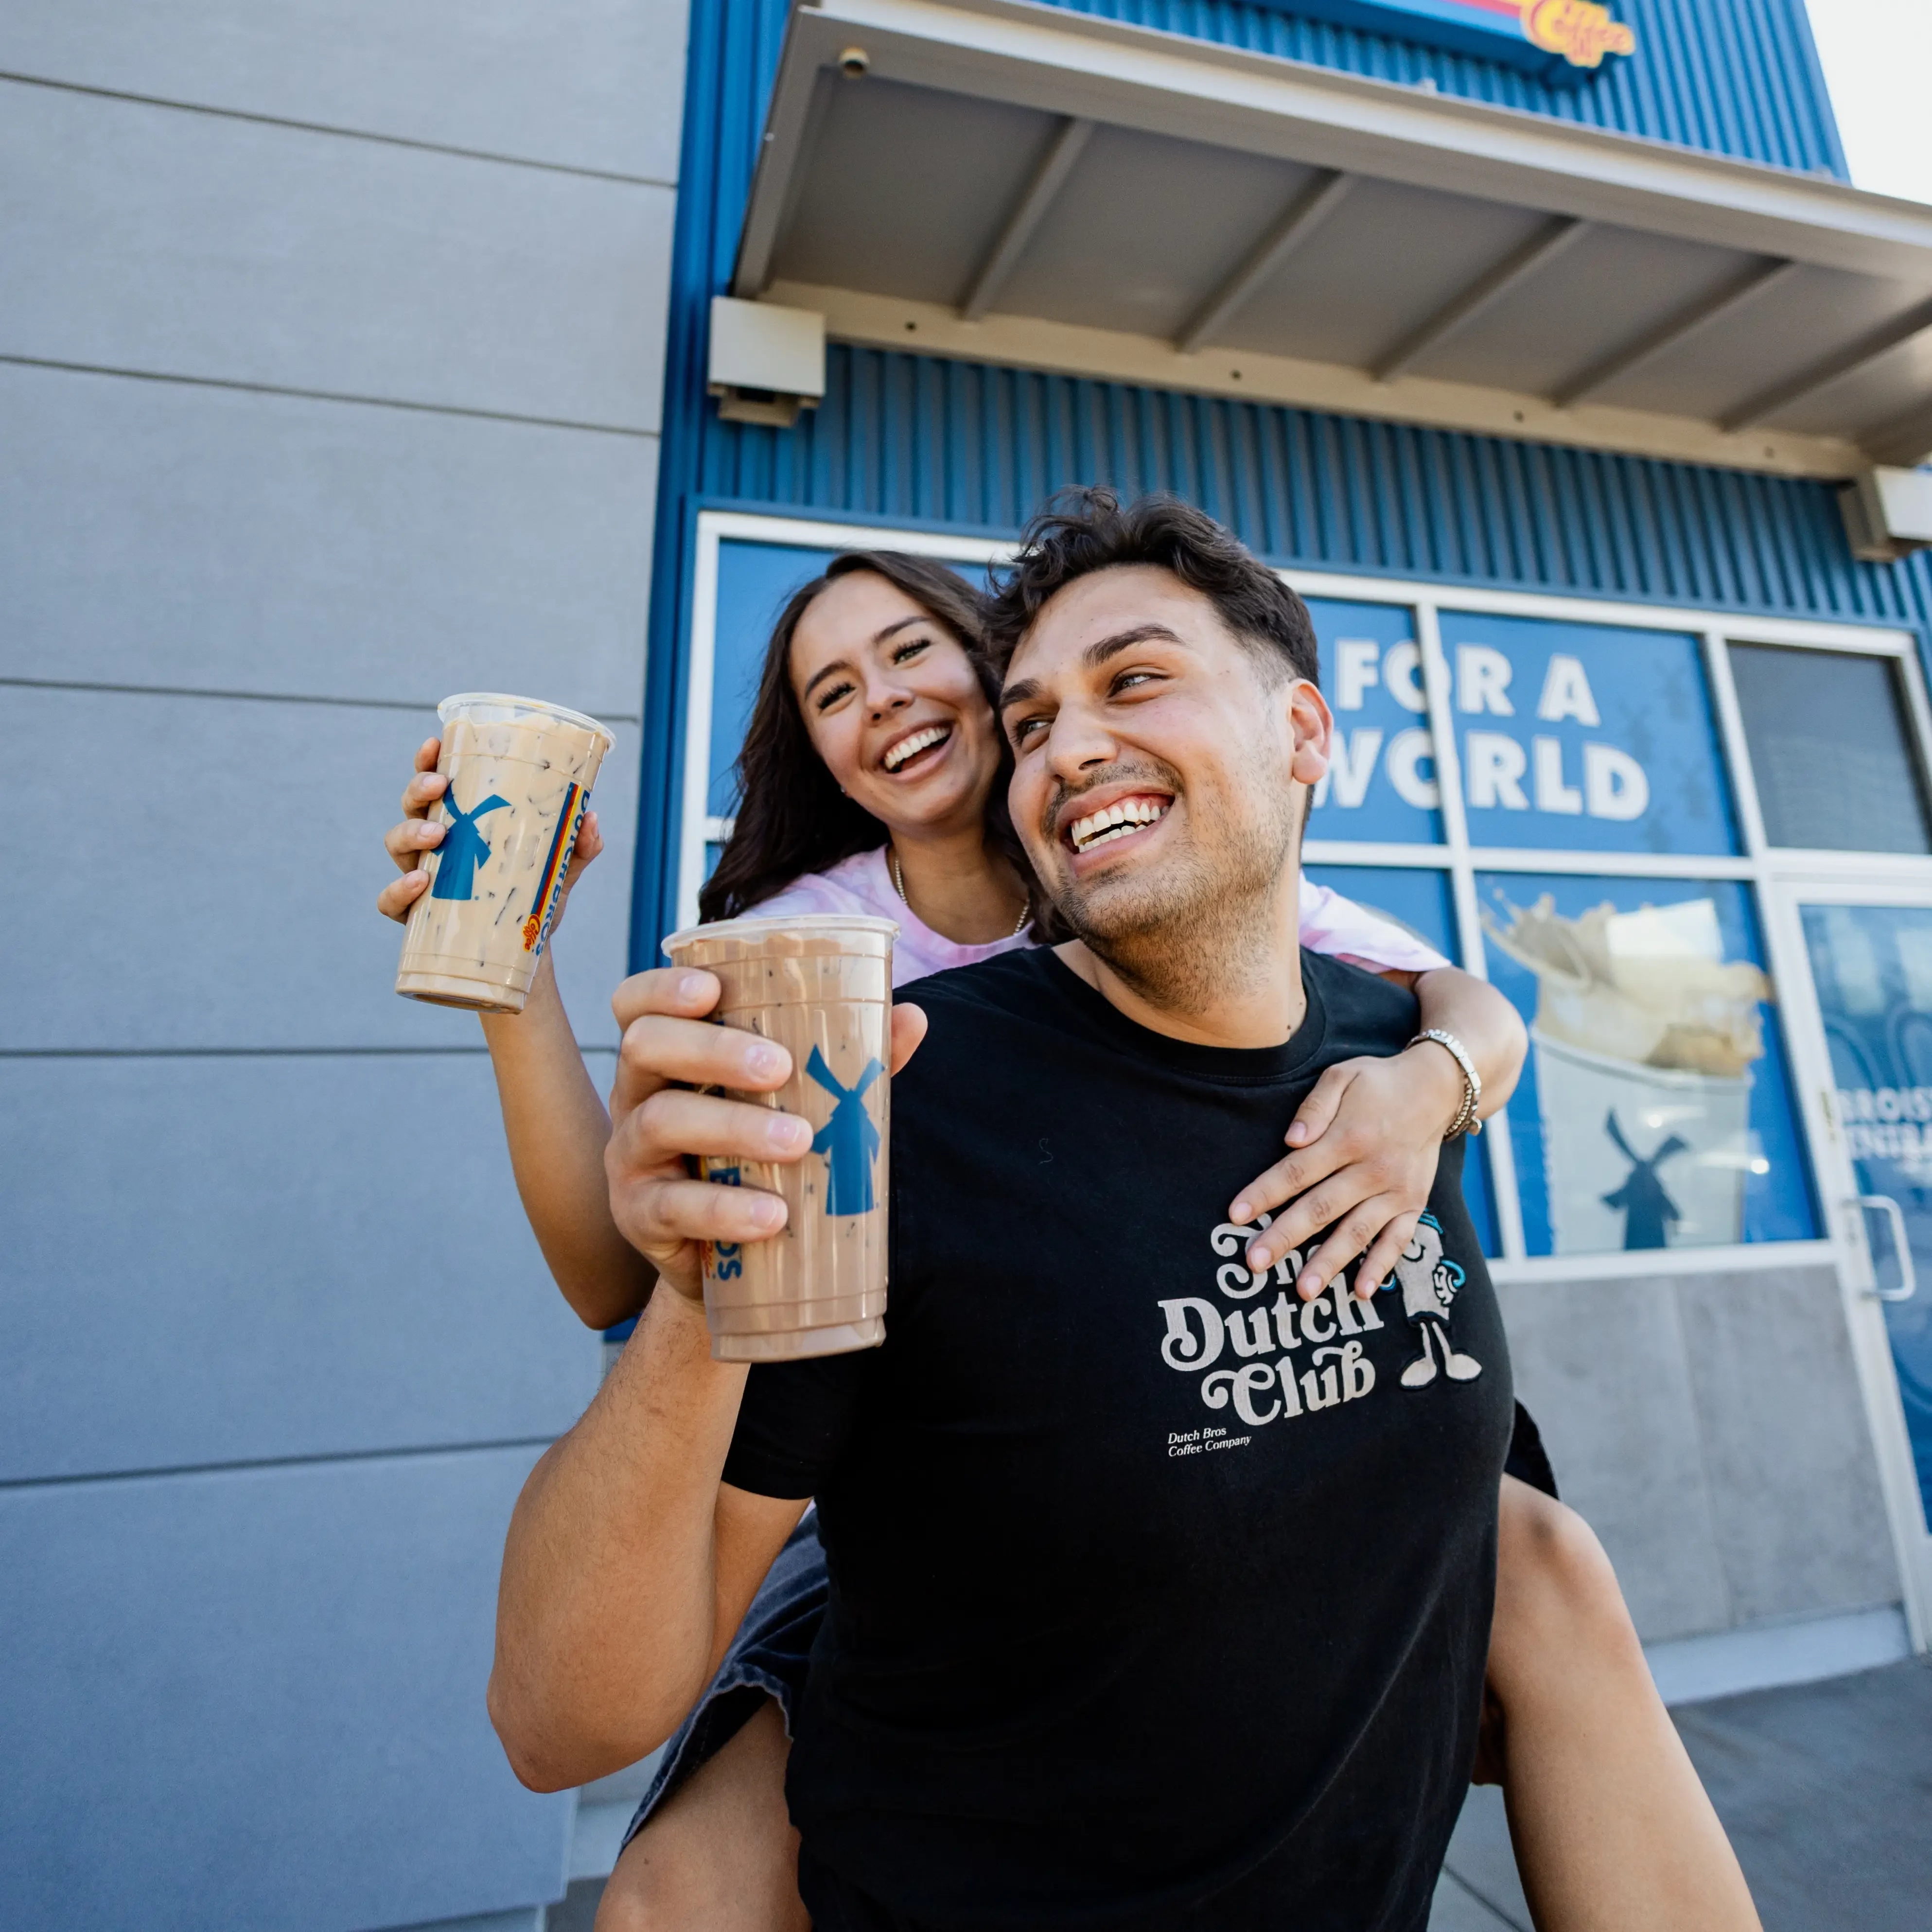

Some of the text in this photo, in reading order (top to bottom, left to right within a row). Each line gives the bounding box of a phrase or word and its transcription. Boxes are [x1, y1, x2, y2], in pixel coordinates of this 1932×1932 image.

[1335, 639, 1601, 727] FOR A
[1314, 726, 1650, 821] WORLD
[1158, 1272, 1385, 1372] Dutch
[1201, 1340, 1376, 1426] Club
[1168, 1428, 1227, 1444] Dutch Bros
[1168, 1436, 1252, 1457] Coffee Company
